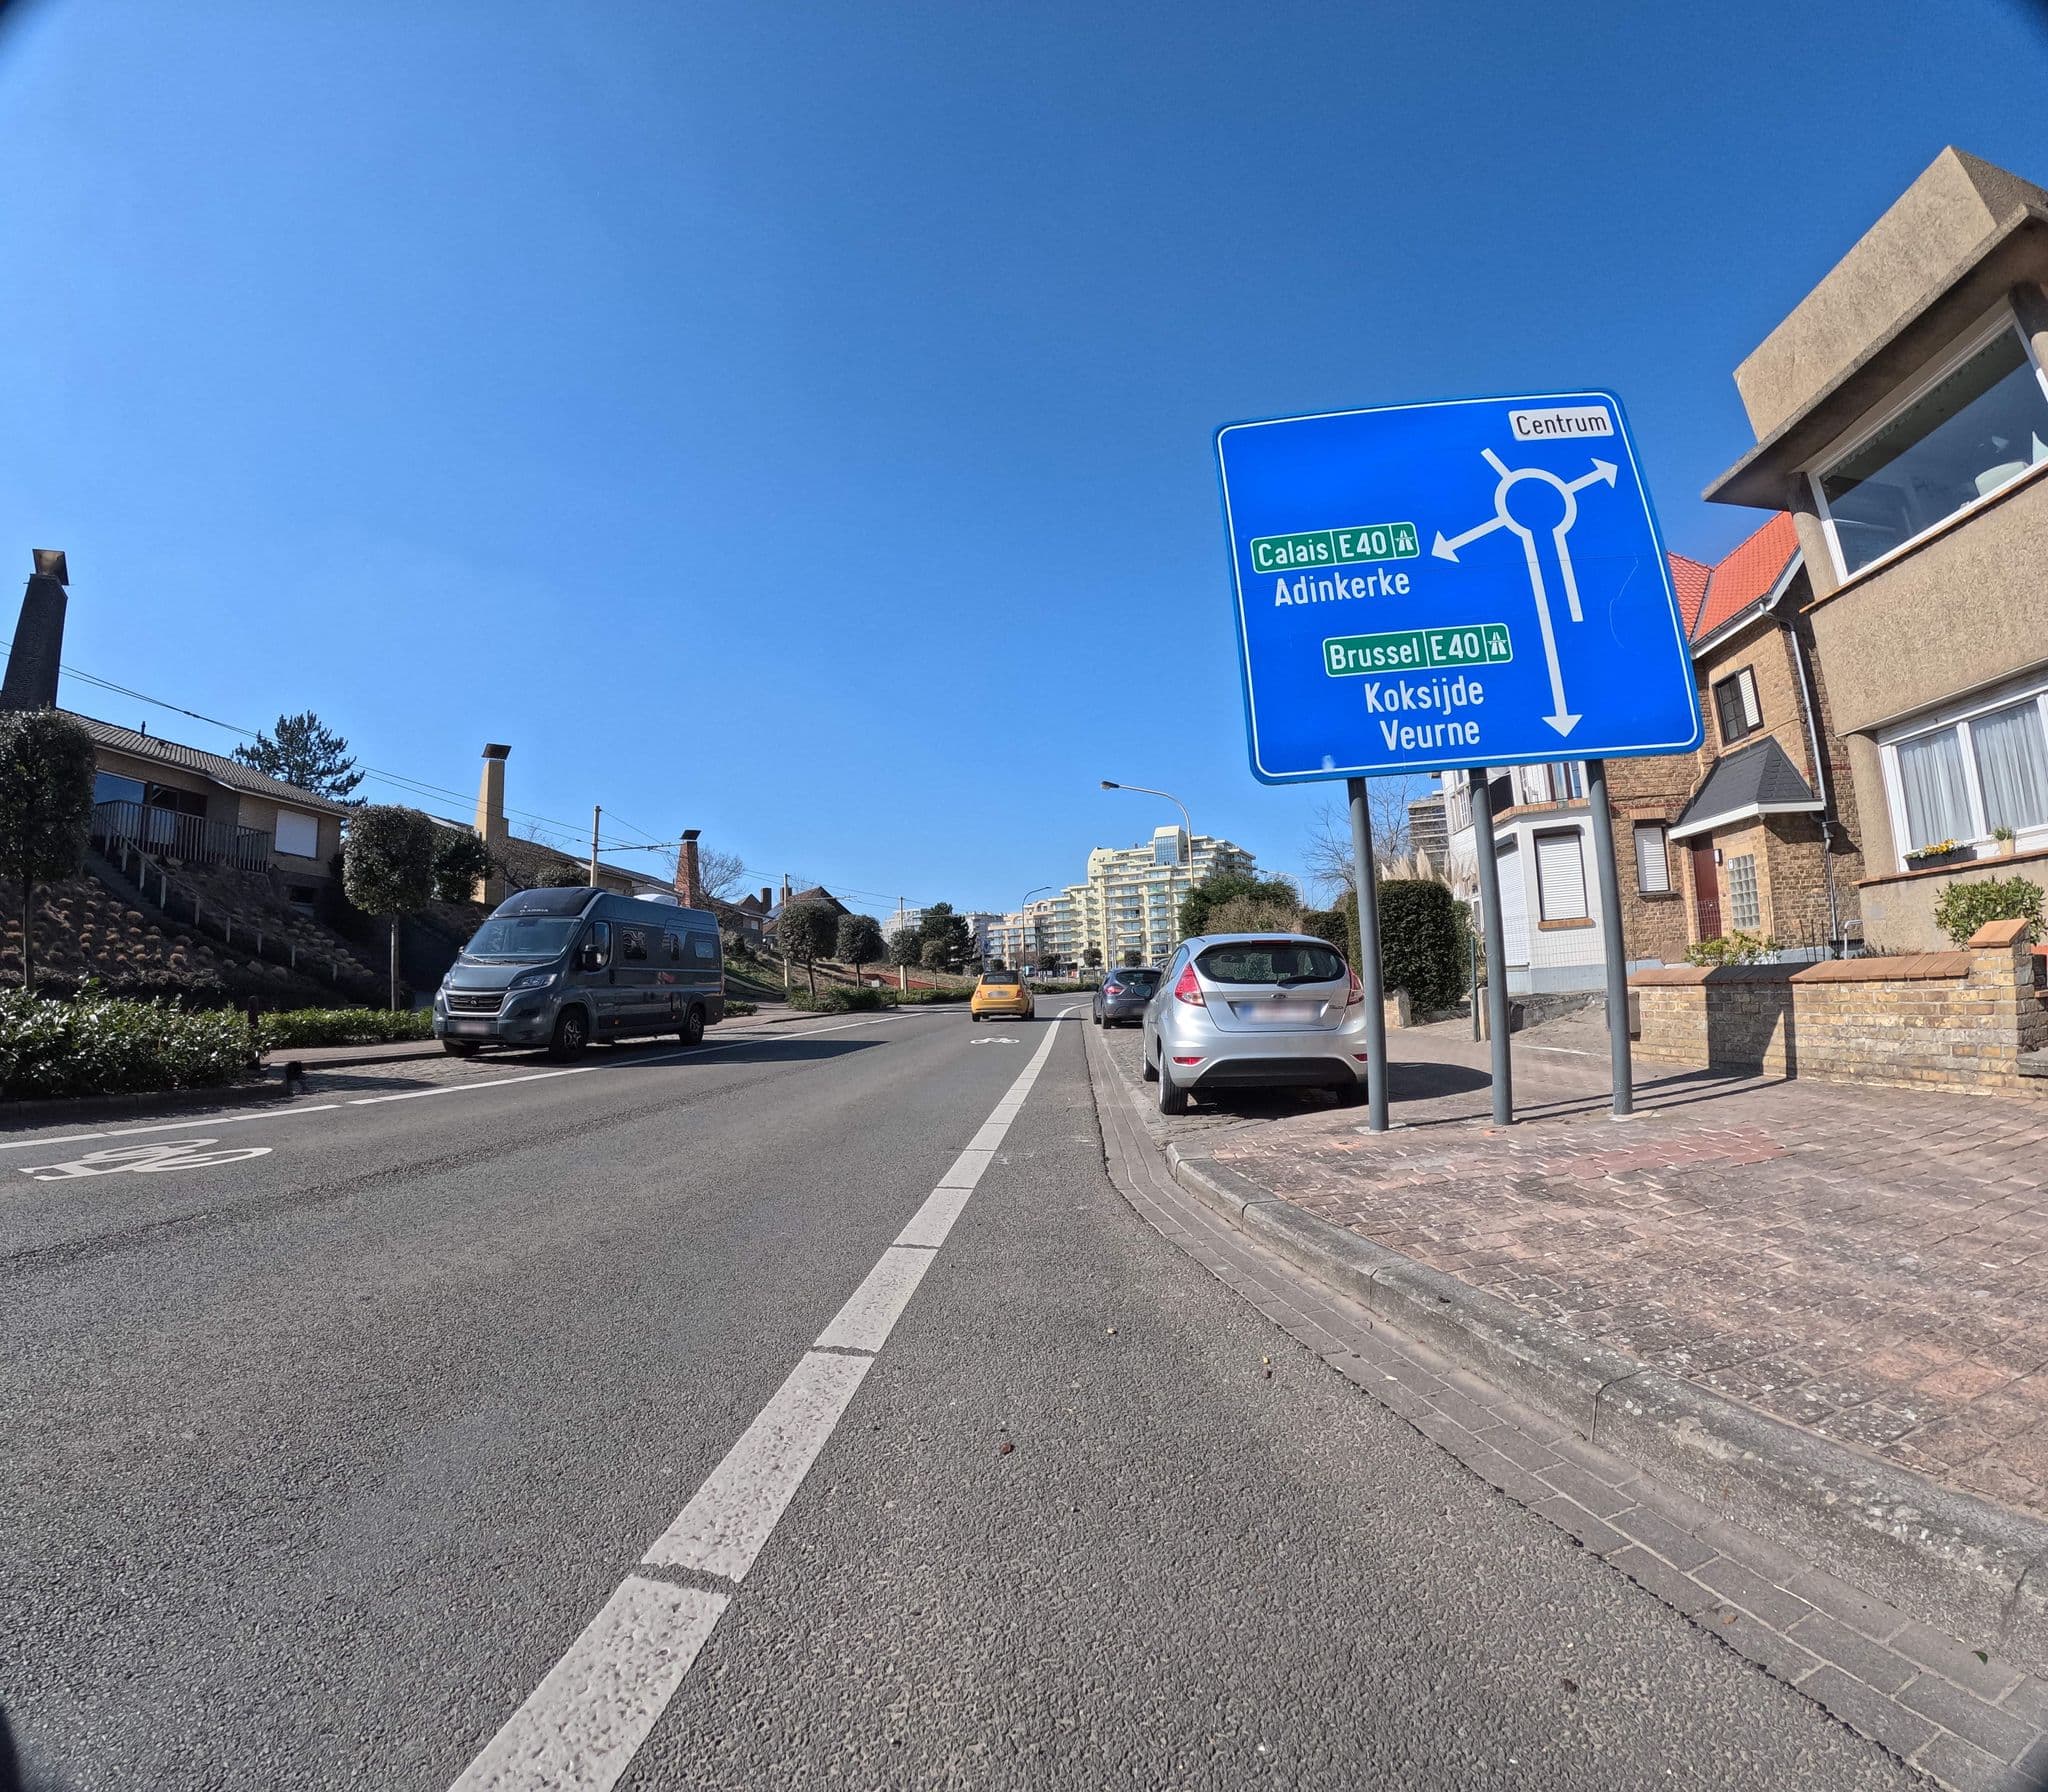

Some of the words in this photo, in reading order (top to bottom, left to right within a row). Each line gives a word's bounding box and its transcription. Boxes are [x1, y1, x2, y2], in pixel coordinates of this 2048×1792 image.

[1516, 414, 1607, 436] Centrum
[1258, 540, 1329, 567] Calais
[1338, 531, 1387, 558] E40
[1275, 568, 1410, 607] Adinkerke
[1329, 639, 1420, 670] Brussel
[1430, 632, 1480, 660] E40
[1364, 675, 1484, 715] Koksijde
[1379, 719, 1480, 751] Veurne
